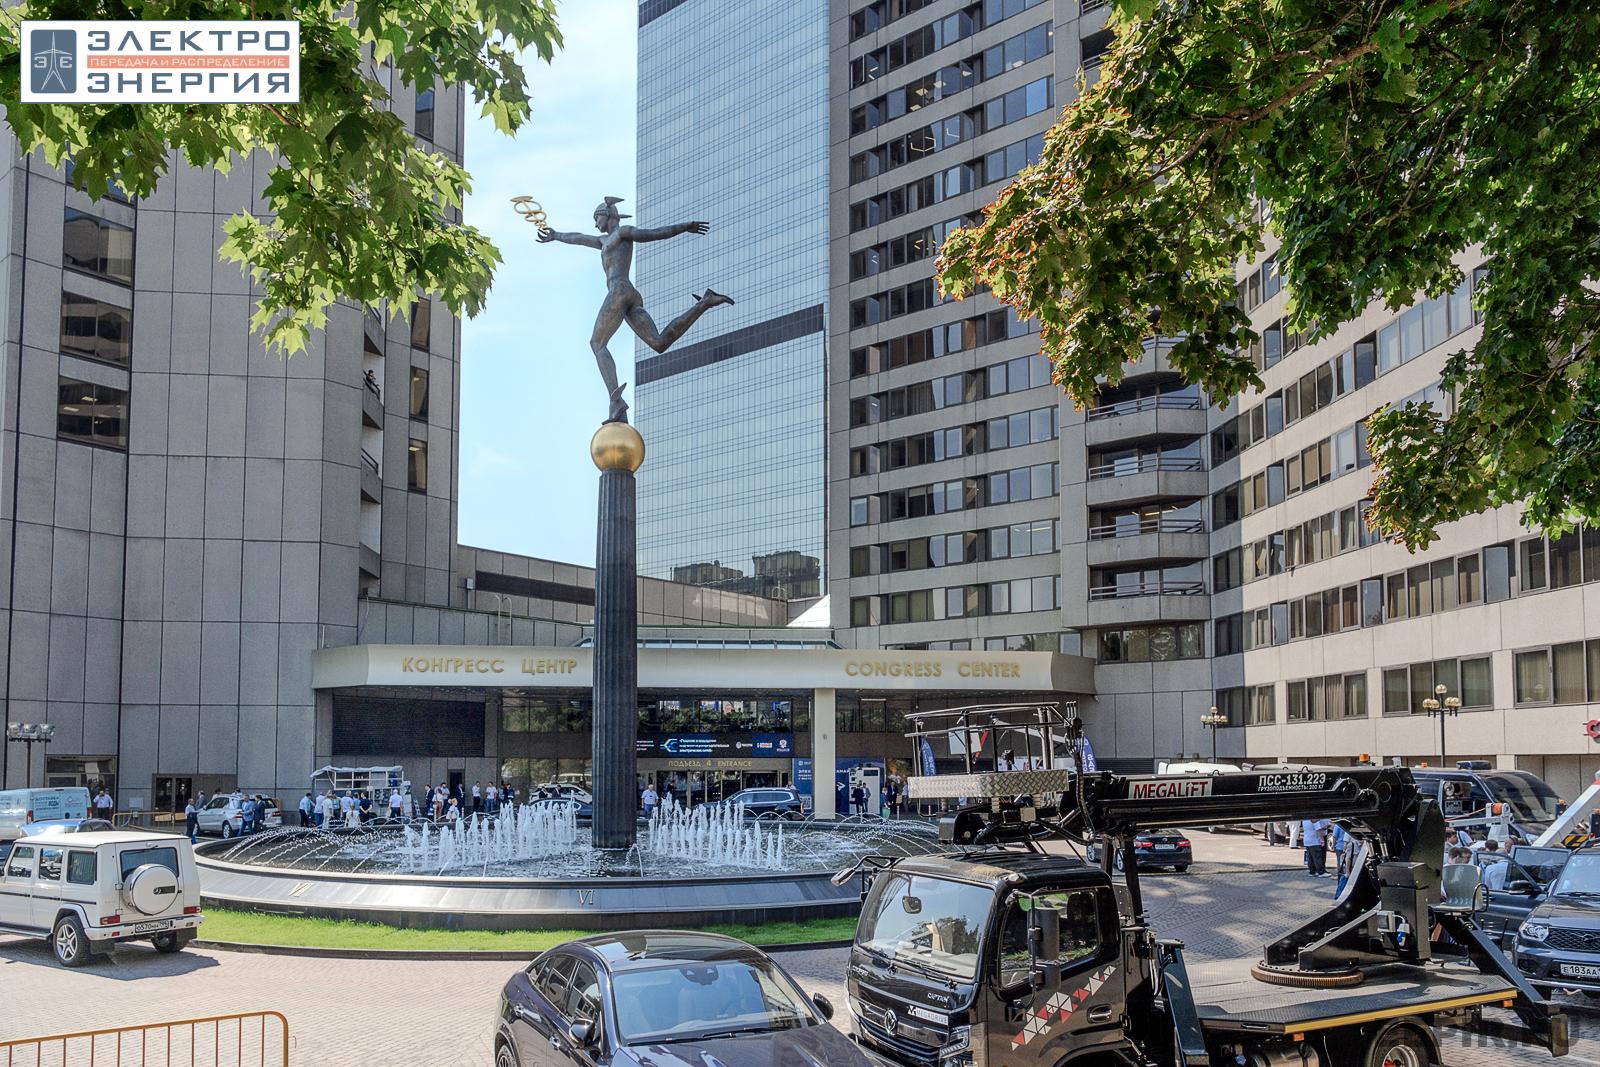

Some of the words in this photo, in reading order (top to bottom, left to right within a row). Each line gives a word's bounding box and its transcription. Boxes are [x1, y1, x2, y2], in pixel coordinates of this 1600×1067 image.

[402, 656, 505, 673] КОНГРЕСС
[521, 658, 578, 675] ЦЕНТР
[845, 661, 943, 677] CONGRESS
[957, 661, 1021, 678] CENTER
[1259, 773, 1326, 786] ПСС-131.22Э
